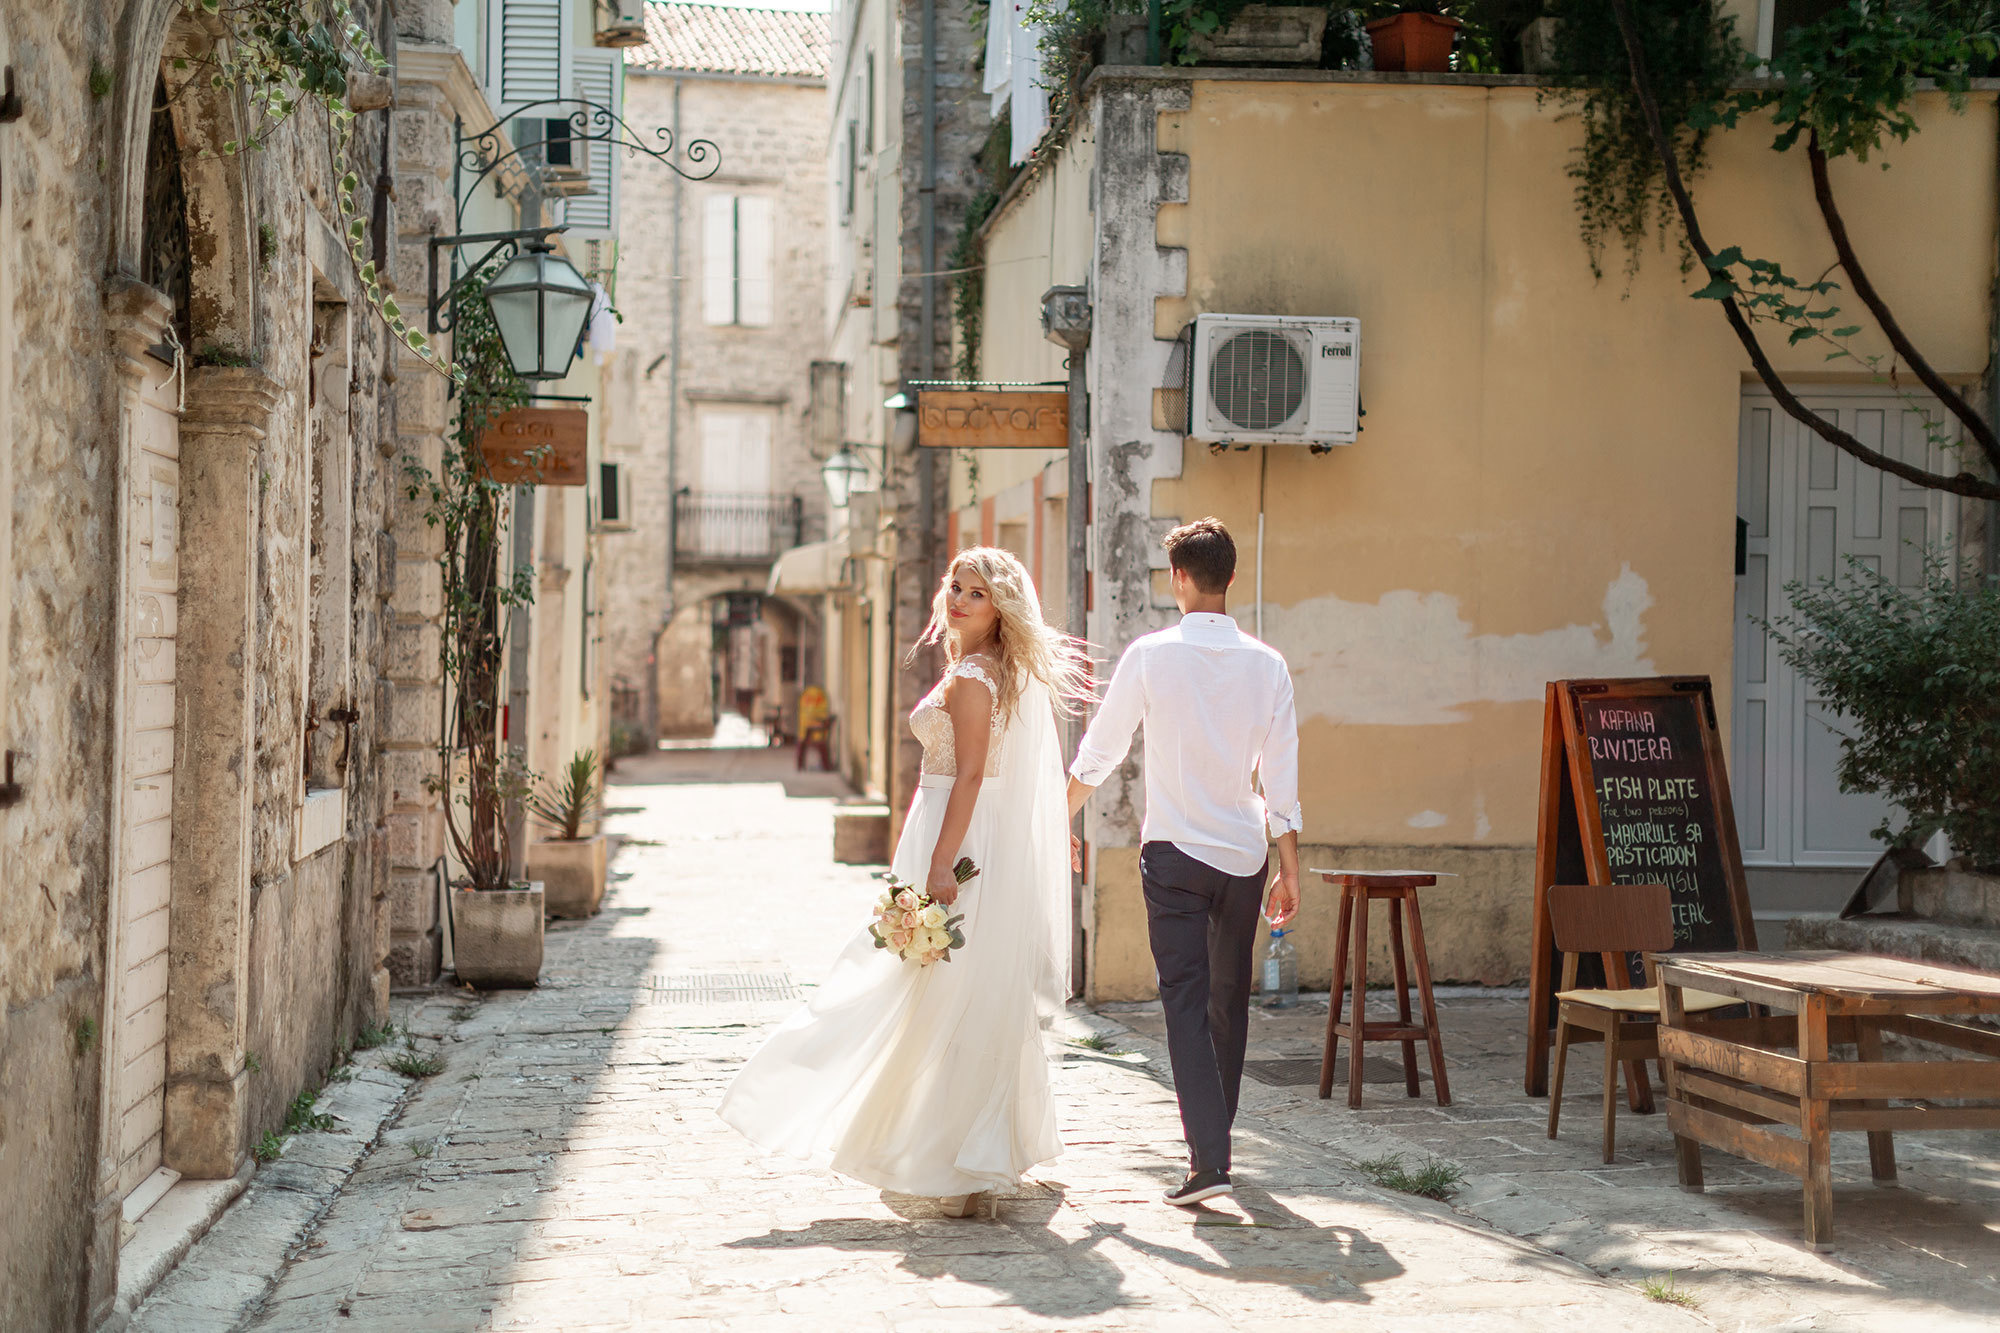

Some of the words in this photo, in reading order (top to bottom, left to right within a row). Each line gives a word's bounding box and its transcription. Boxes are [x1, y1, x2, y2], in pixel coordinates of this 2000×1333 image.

[1599, 709, 1655, 733] KAFANA
[1588, 736, 1672, 763] RIVIJERA
[1647, 777, 1700, 801] PLATE
[1685, 823, 1703, 843] SA
[1671, 901, 1713, 925] TEAK
